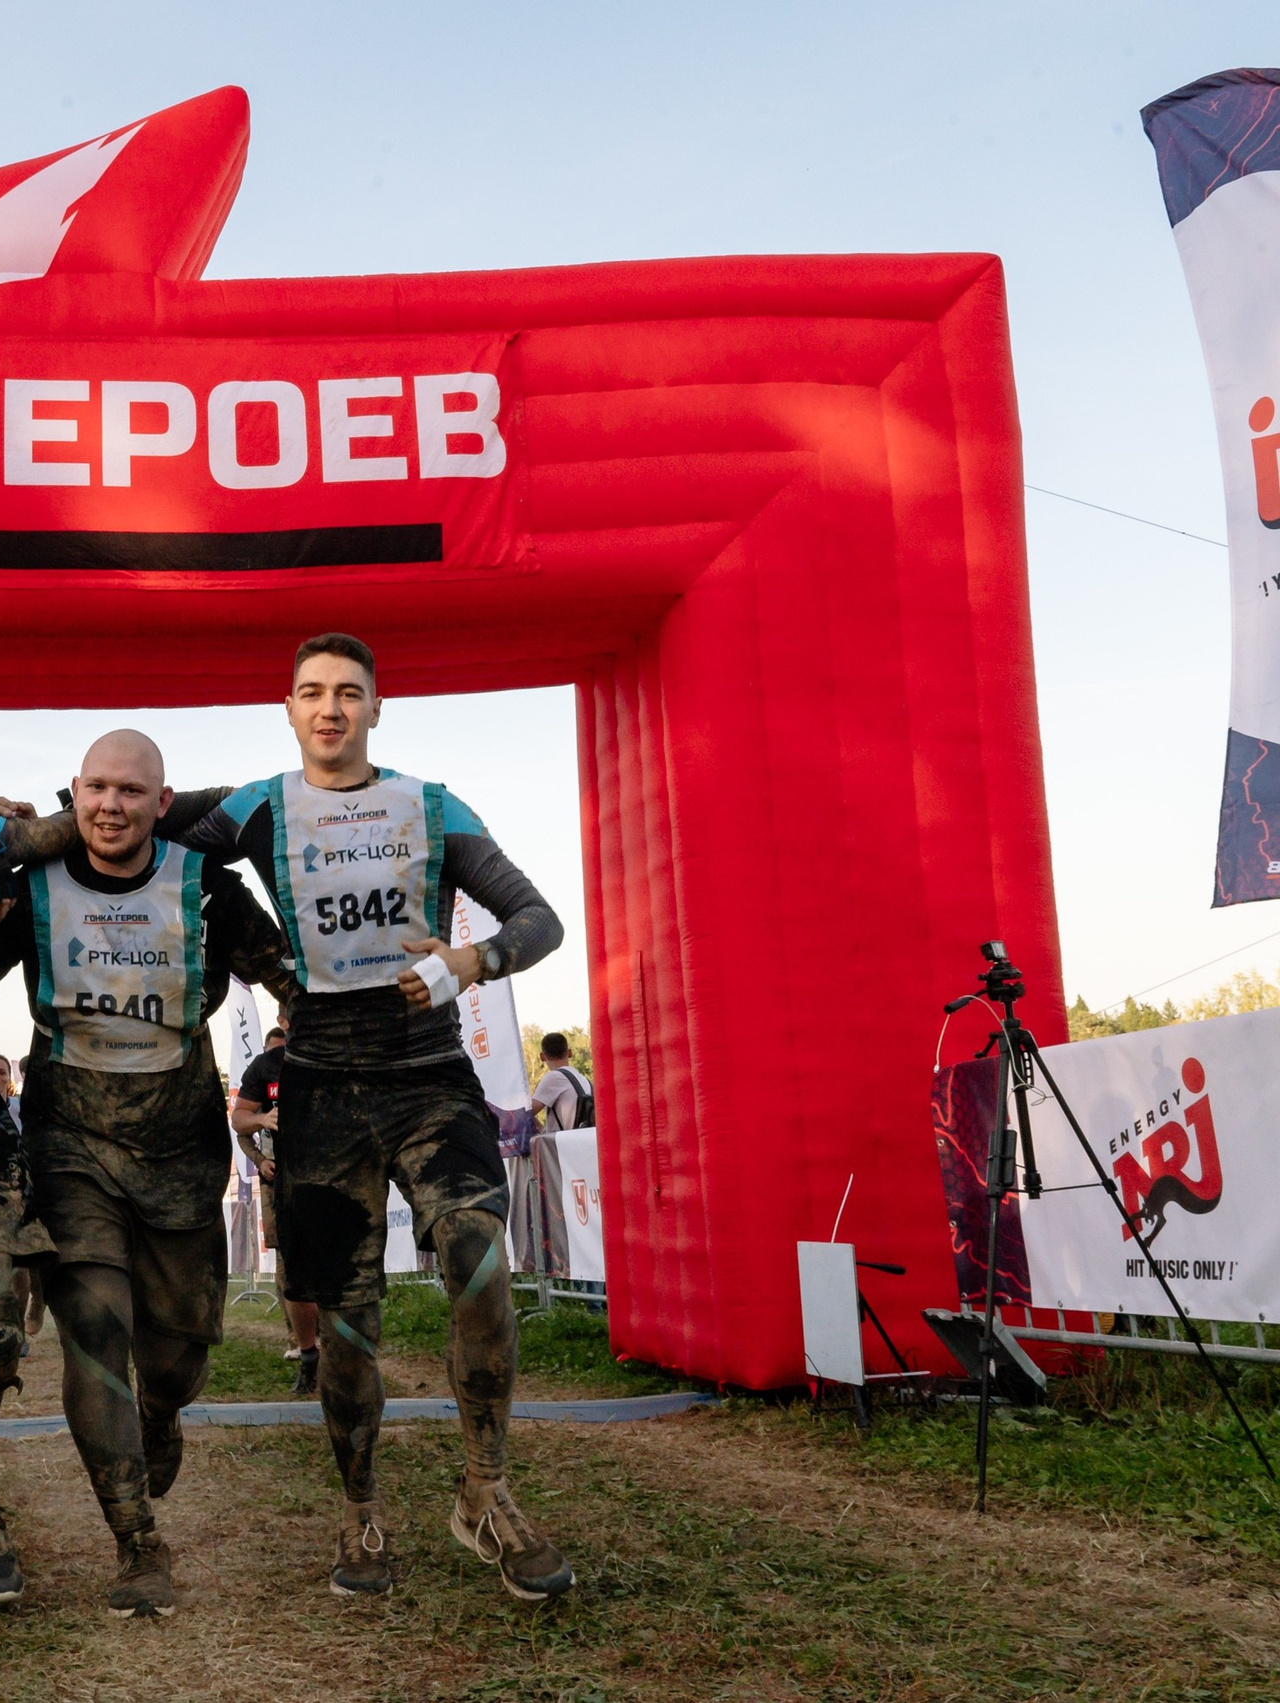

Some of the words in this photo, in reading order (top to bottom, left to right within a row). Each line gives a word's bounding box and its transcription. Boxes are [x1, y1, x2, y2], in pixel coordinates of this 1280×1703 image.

[317, 814, 348, 824] ГОНКА
[351, 809, 387, 820] ГЕРОЕВ
[324, 843, 410, 866] РТК-ЦОД
[115, 914, 149, 922] ГЕРОЕВ
[315, 887, 409, 936] 5842
[88, 950, 169, 967] РТК-ЦОД
[350, 953, 407, 968] ГАЗПРОМБАНК
[105, 1041, 158, 1050] ГАЗПРОМБАНК
[1109, 1089, 1181, 1155] ENERGY
[1126, 1258, 1145, 1277] HIT
[1193, 1260, 1226, 1281] ONLY
